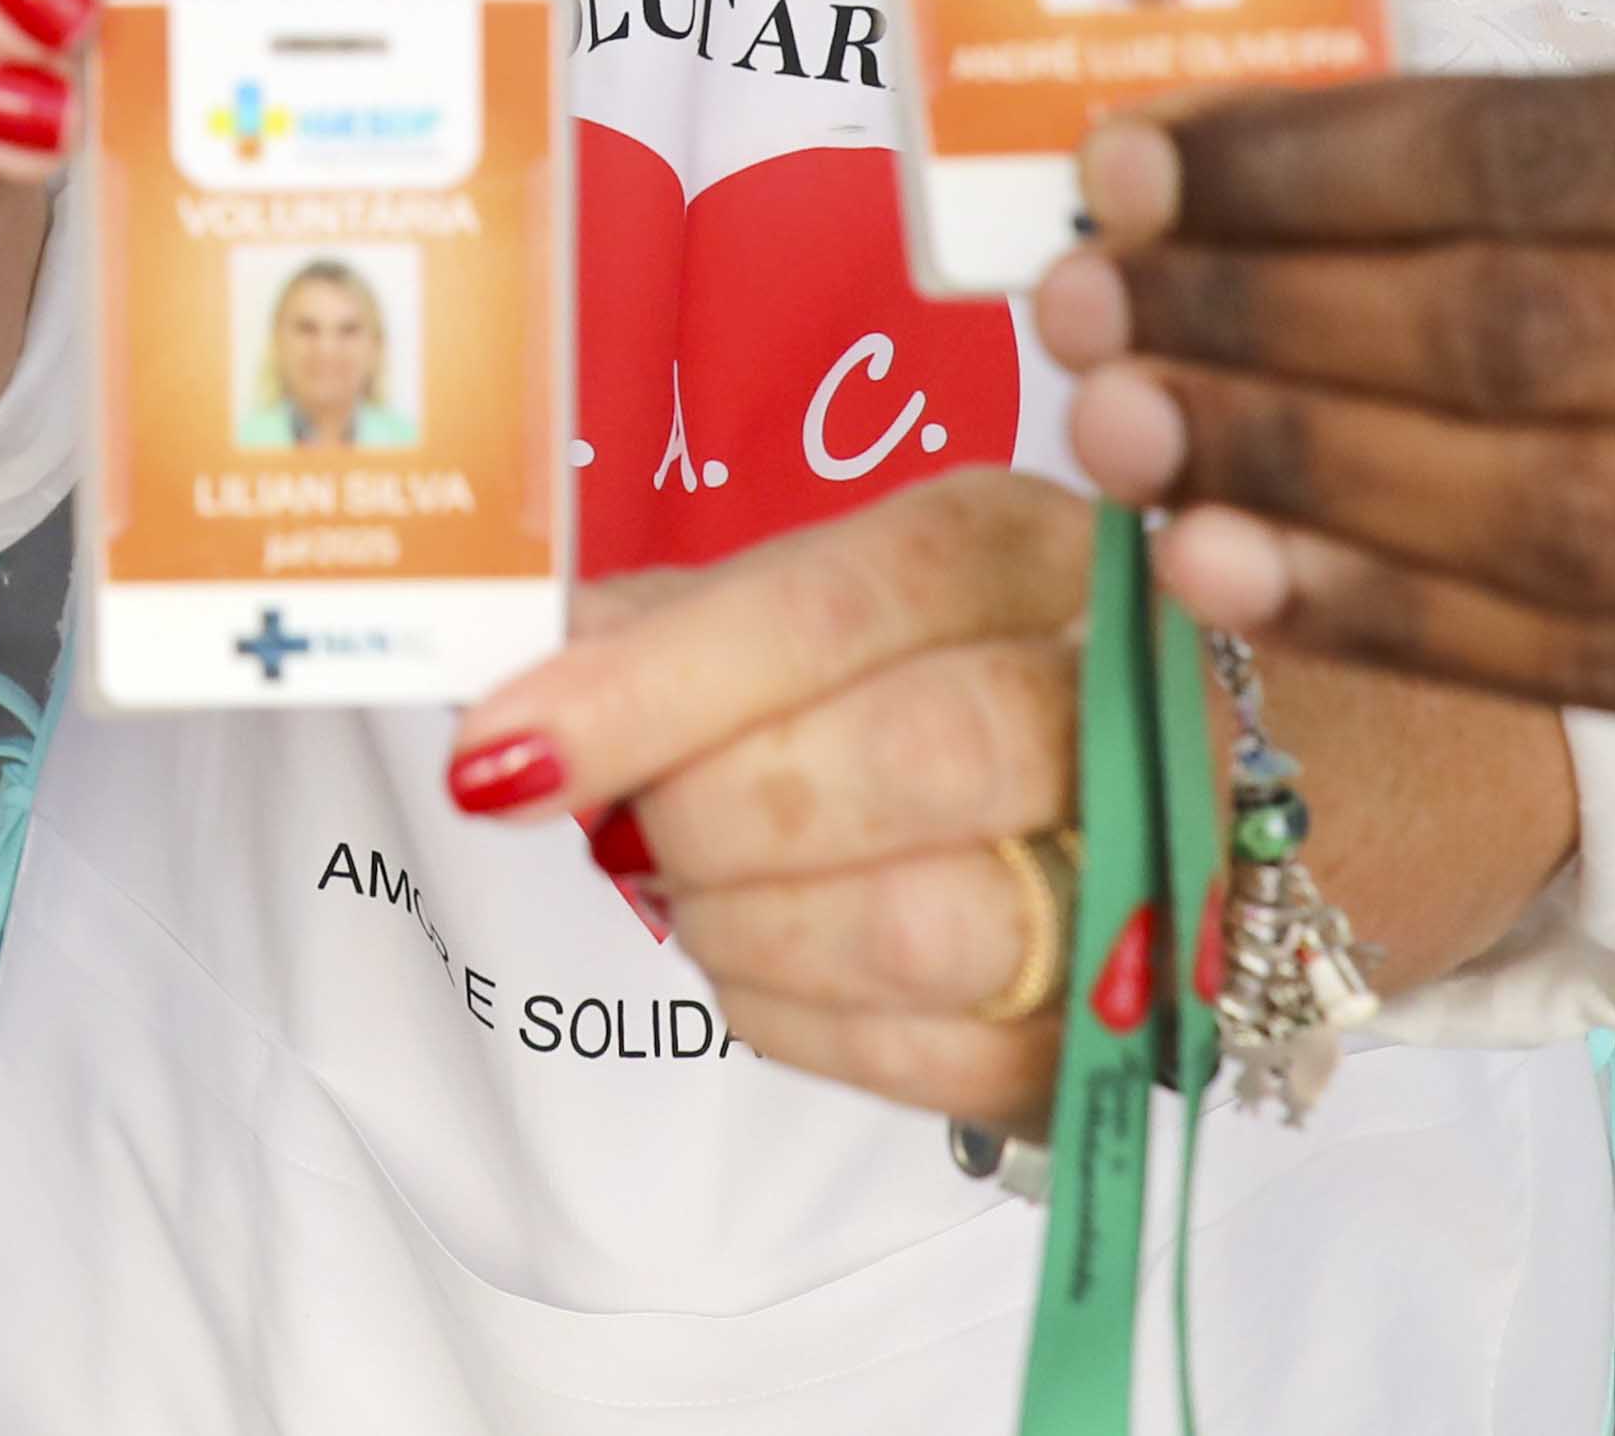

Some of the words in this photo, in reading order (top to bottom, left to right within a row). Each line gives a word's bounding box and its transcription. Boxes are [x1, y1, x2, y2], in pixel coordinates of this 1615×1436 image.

[192, 470, 336, 520] LILIAN
[343, 468, 477, 518] SILVA
[464, 966, 496, 1030] E
